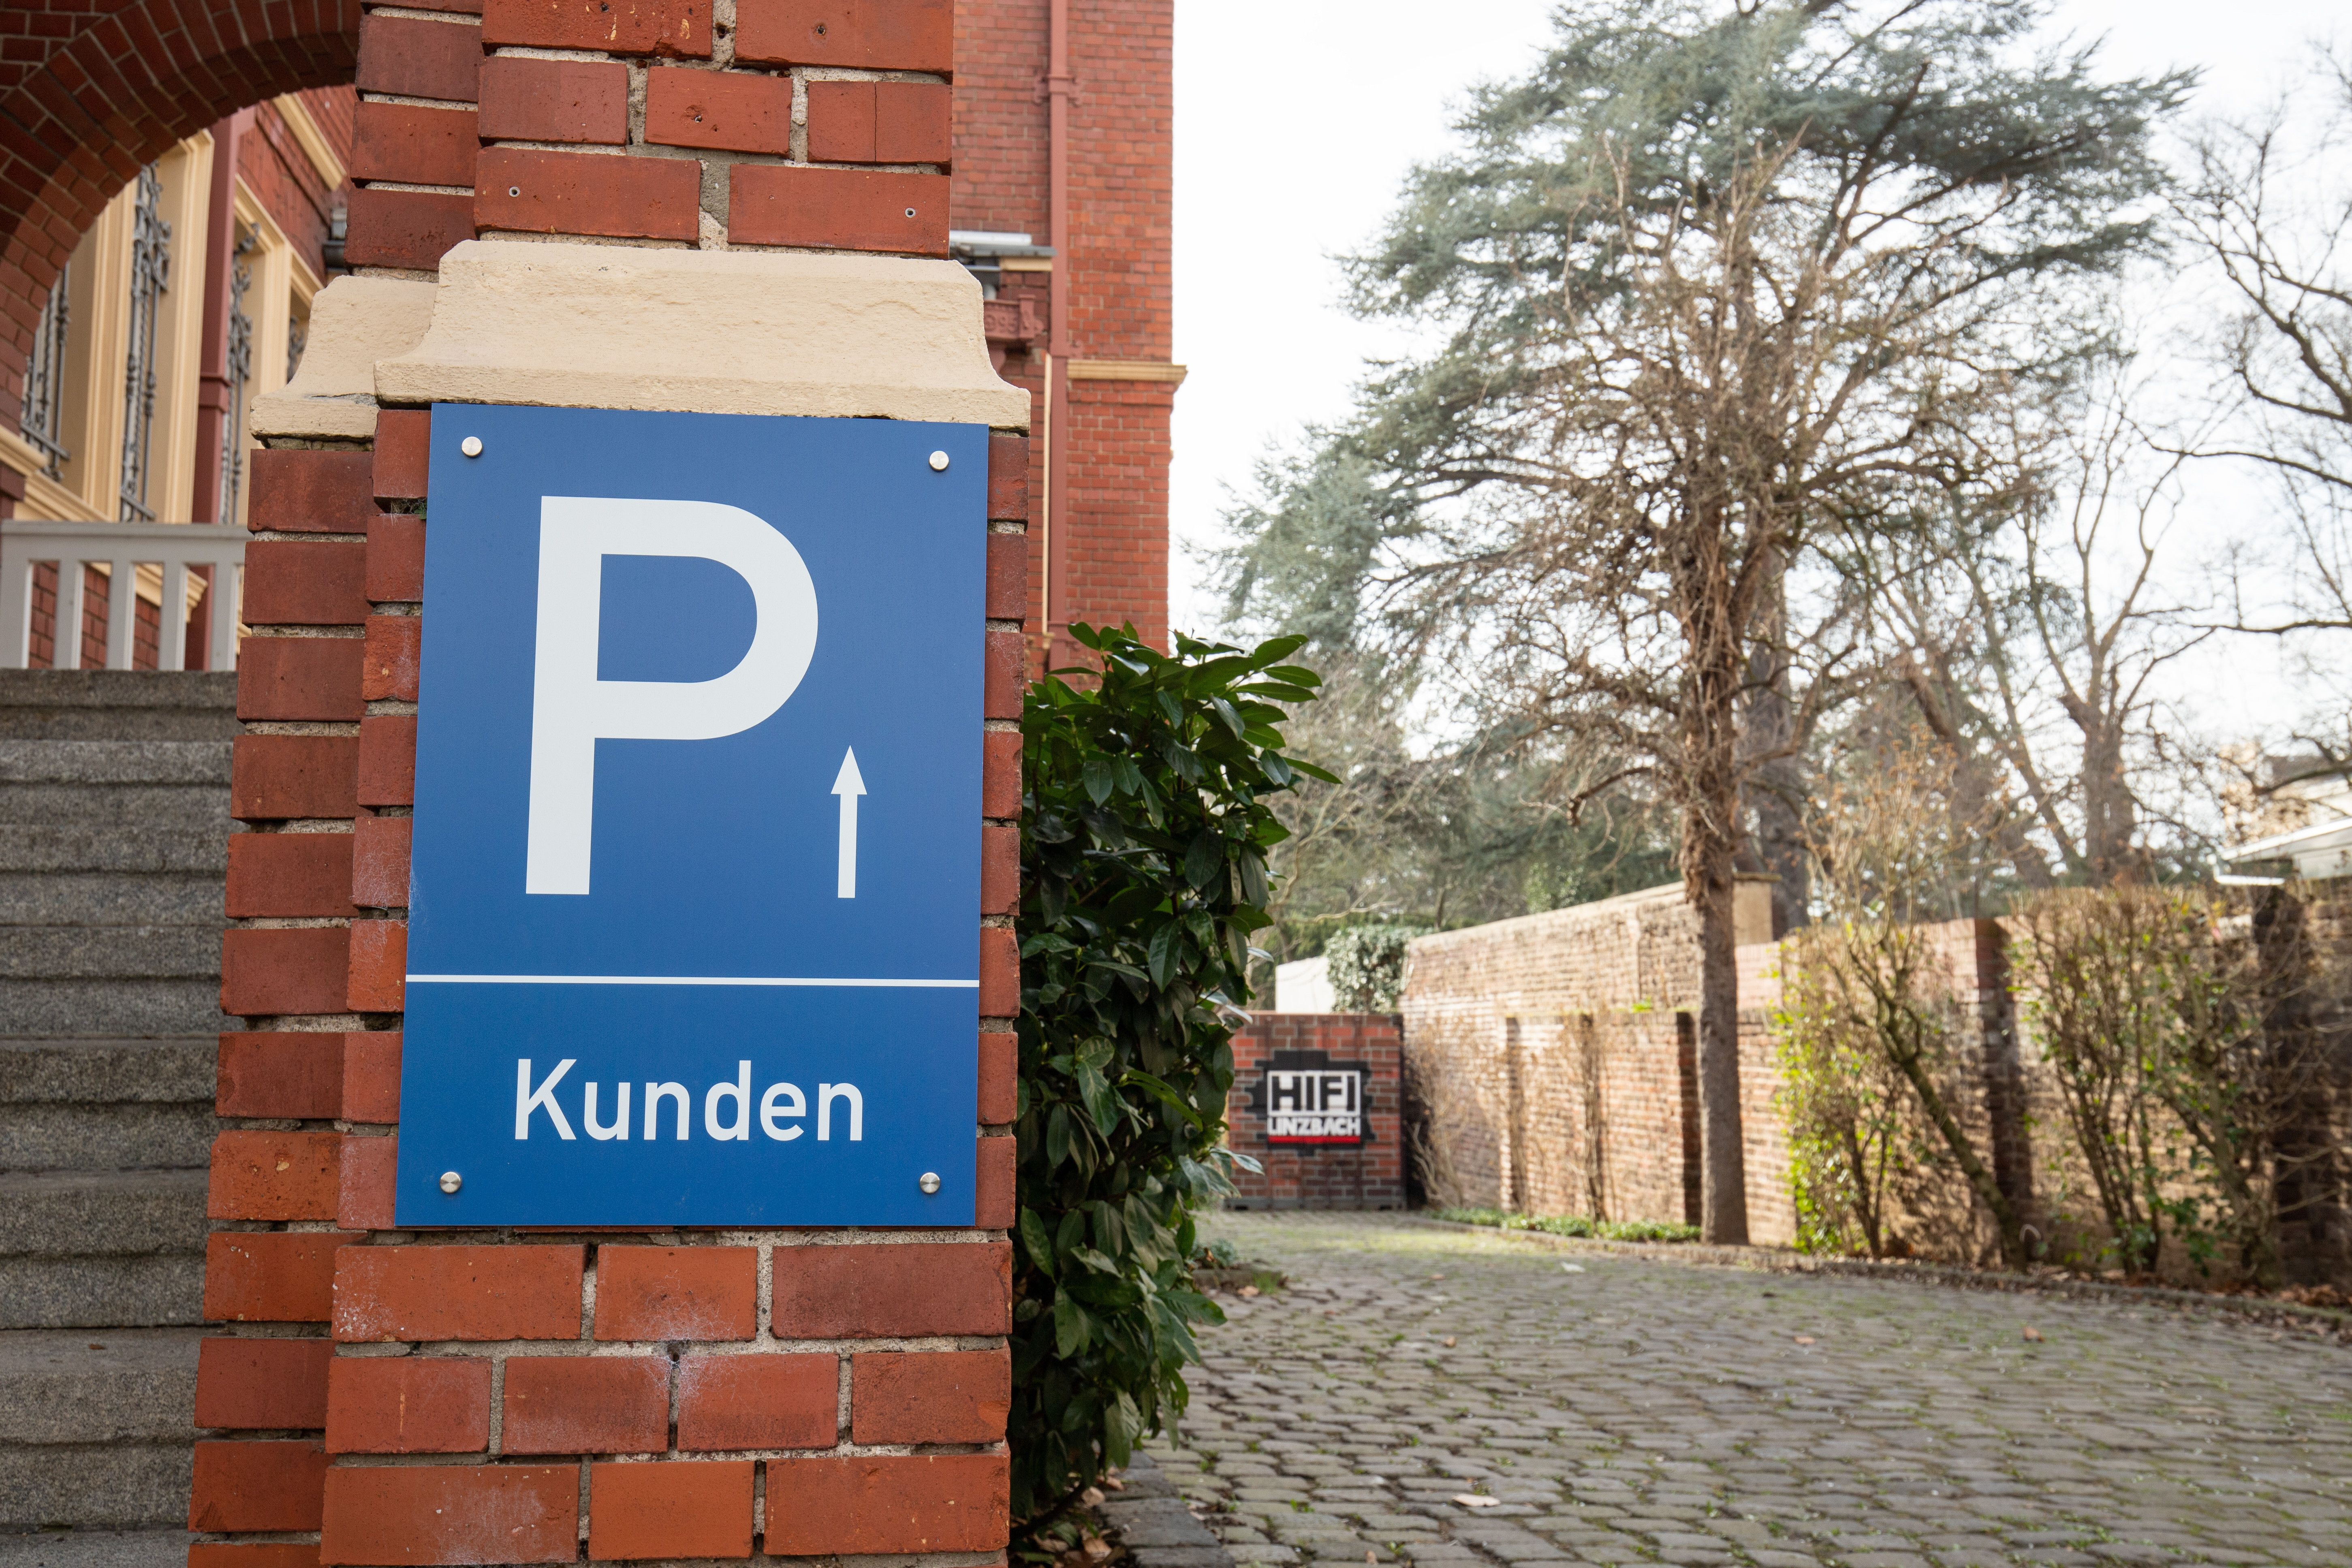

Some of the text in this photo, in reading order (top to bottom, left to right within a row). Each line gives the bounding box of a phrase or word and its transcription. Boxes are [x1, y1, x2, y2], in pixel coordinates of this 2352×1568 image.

[526, 496, 819, 897] P
[515, 1058, 863, 1141] Kunden
[1271, 1075, 1357, 1111] HIFI
[1267, 1117, 1361, 1136] LINZBACH
